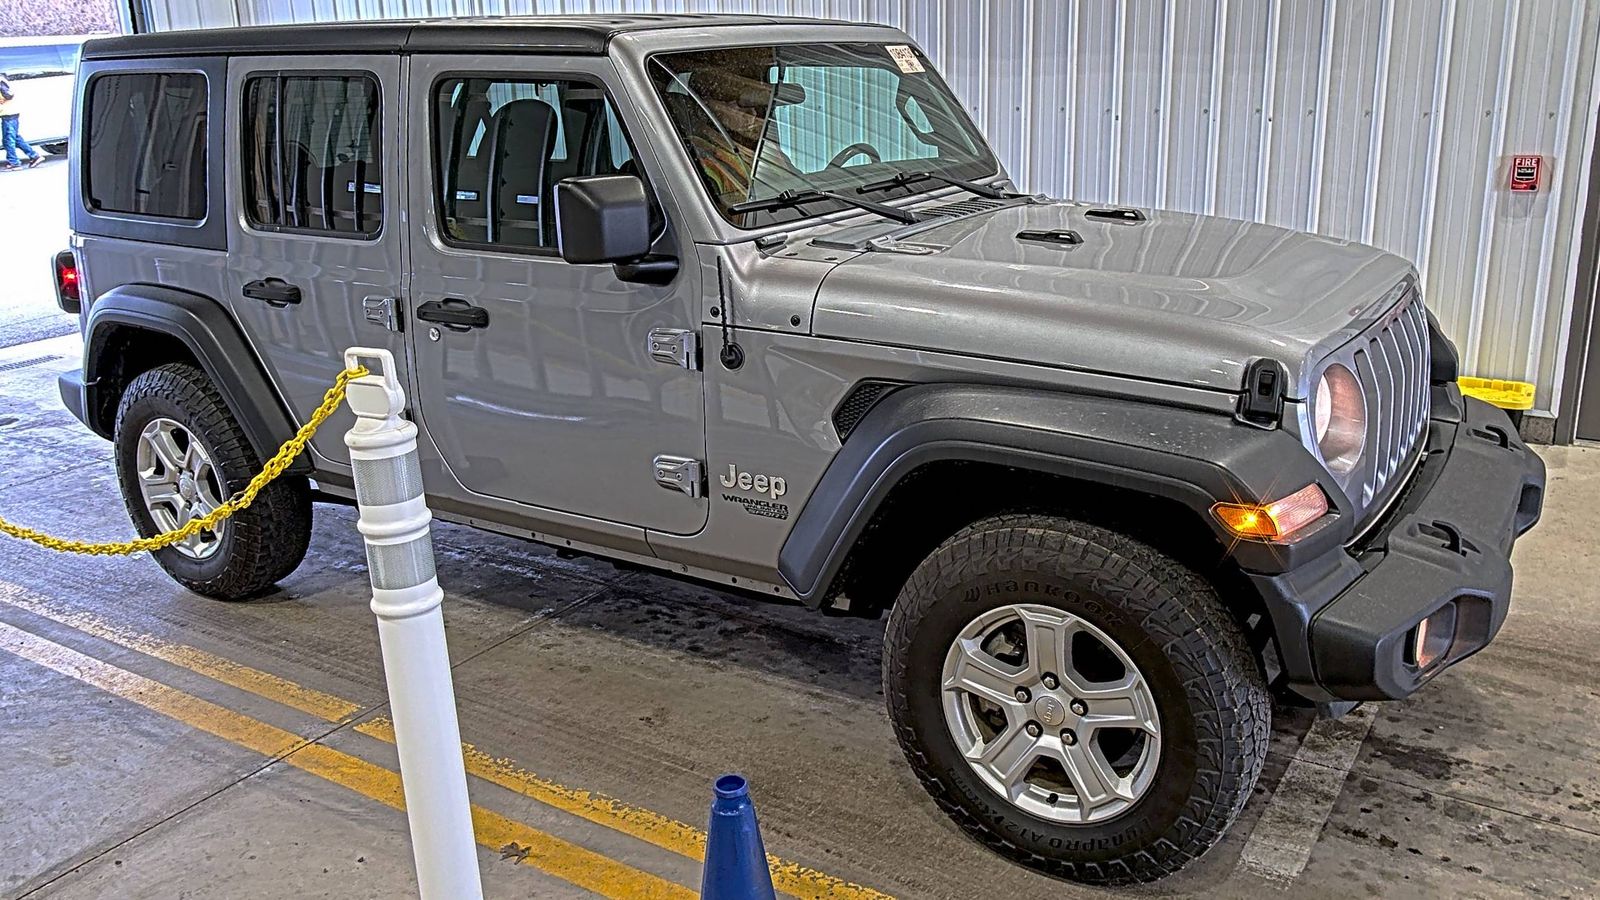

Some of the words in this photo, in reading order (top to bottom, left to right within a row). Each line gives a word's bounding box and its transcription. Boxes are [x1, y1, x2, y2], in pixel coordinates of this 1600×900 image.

[1515, 158, 1538, 166] FIRE
[720, 464, 786, 499] Jeep
[722, 494, 788, 511] WRANGLER
